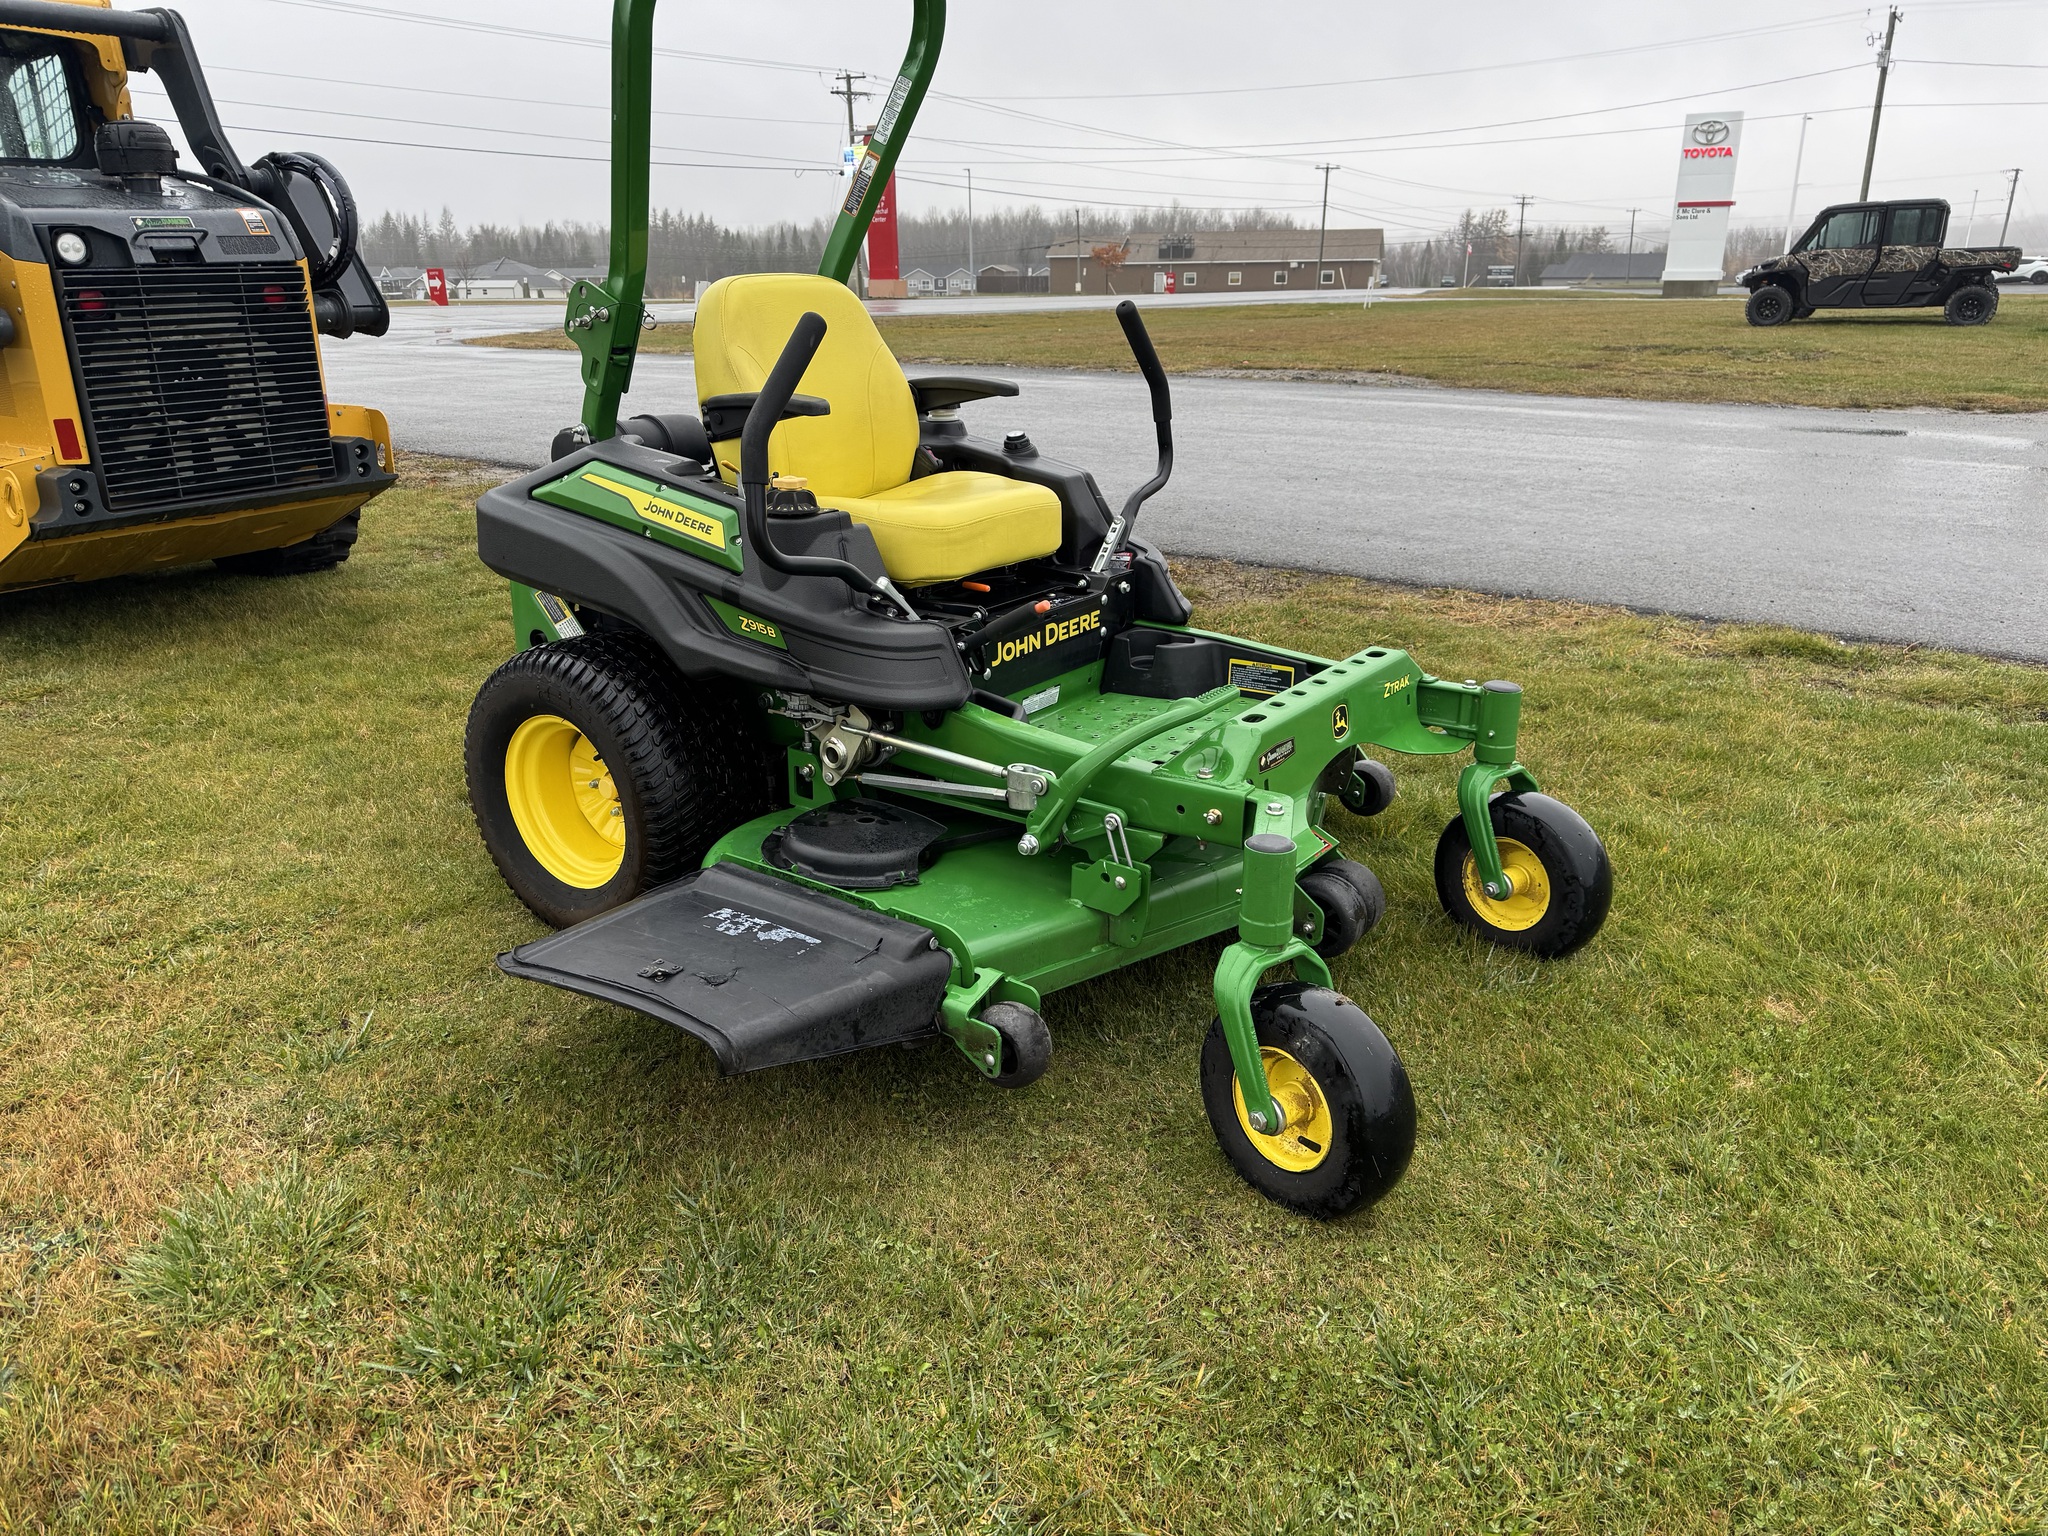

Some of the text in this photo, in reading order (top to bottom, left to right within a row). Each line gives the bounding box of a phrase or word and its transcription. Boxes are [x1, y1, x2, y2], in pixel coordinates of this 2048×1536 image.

[1683, 147, 1733, 158] TOYOTA
[643, 500, 714, 535] JOHN DEERE
[991, 609, 1100, 667] JOHN DEERE
[1383, 673, 1410, 699] ZTRAK
